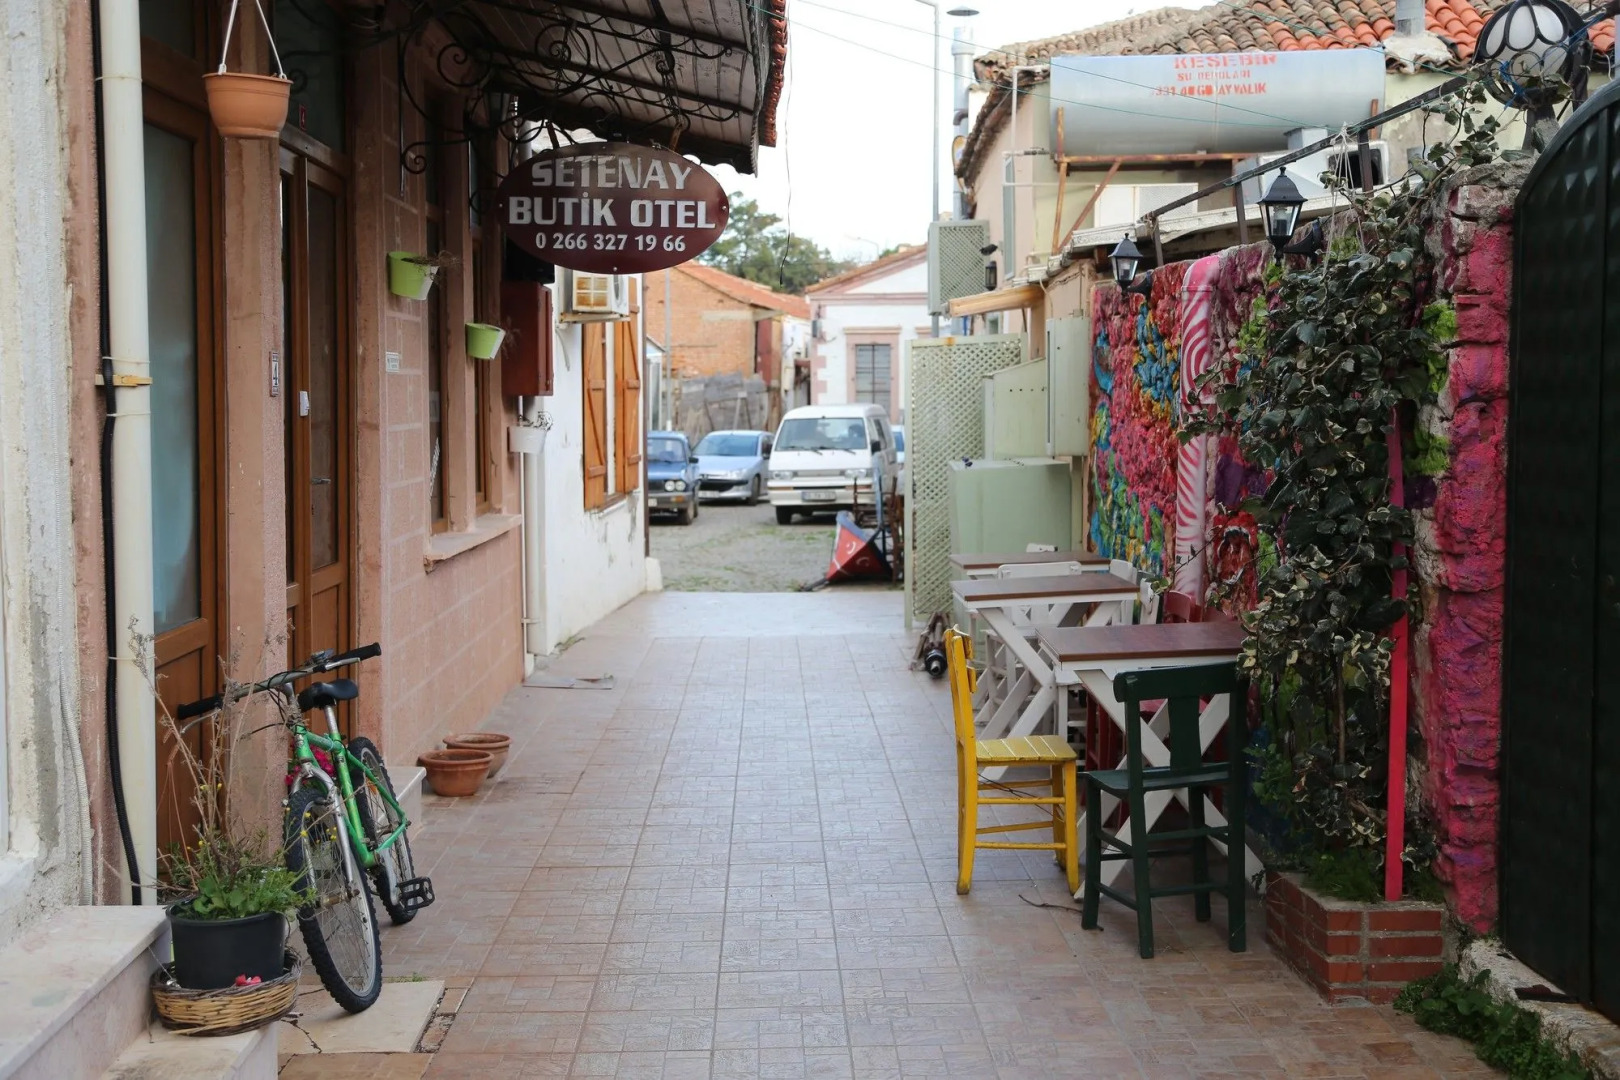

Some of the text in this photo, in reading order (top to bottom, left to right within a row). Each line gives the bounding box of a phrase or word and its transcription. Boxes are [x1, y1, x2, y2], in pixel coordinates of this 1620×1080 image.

[532, 155, 692, 190] SETENAY
[509, 192, 716, 228] BUTİK OTEL
[536, 232, 686, 251] 0 266 327 19 66
